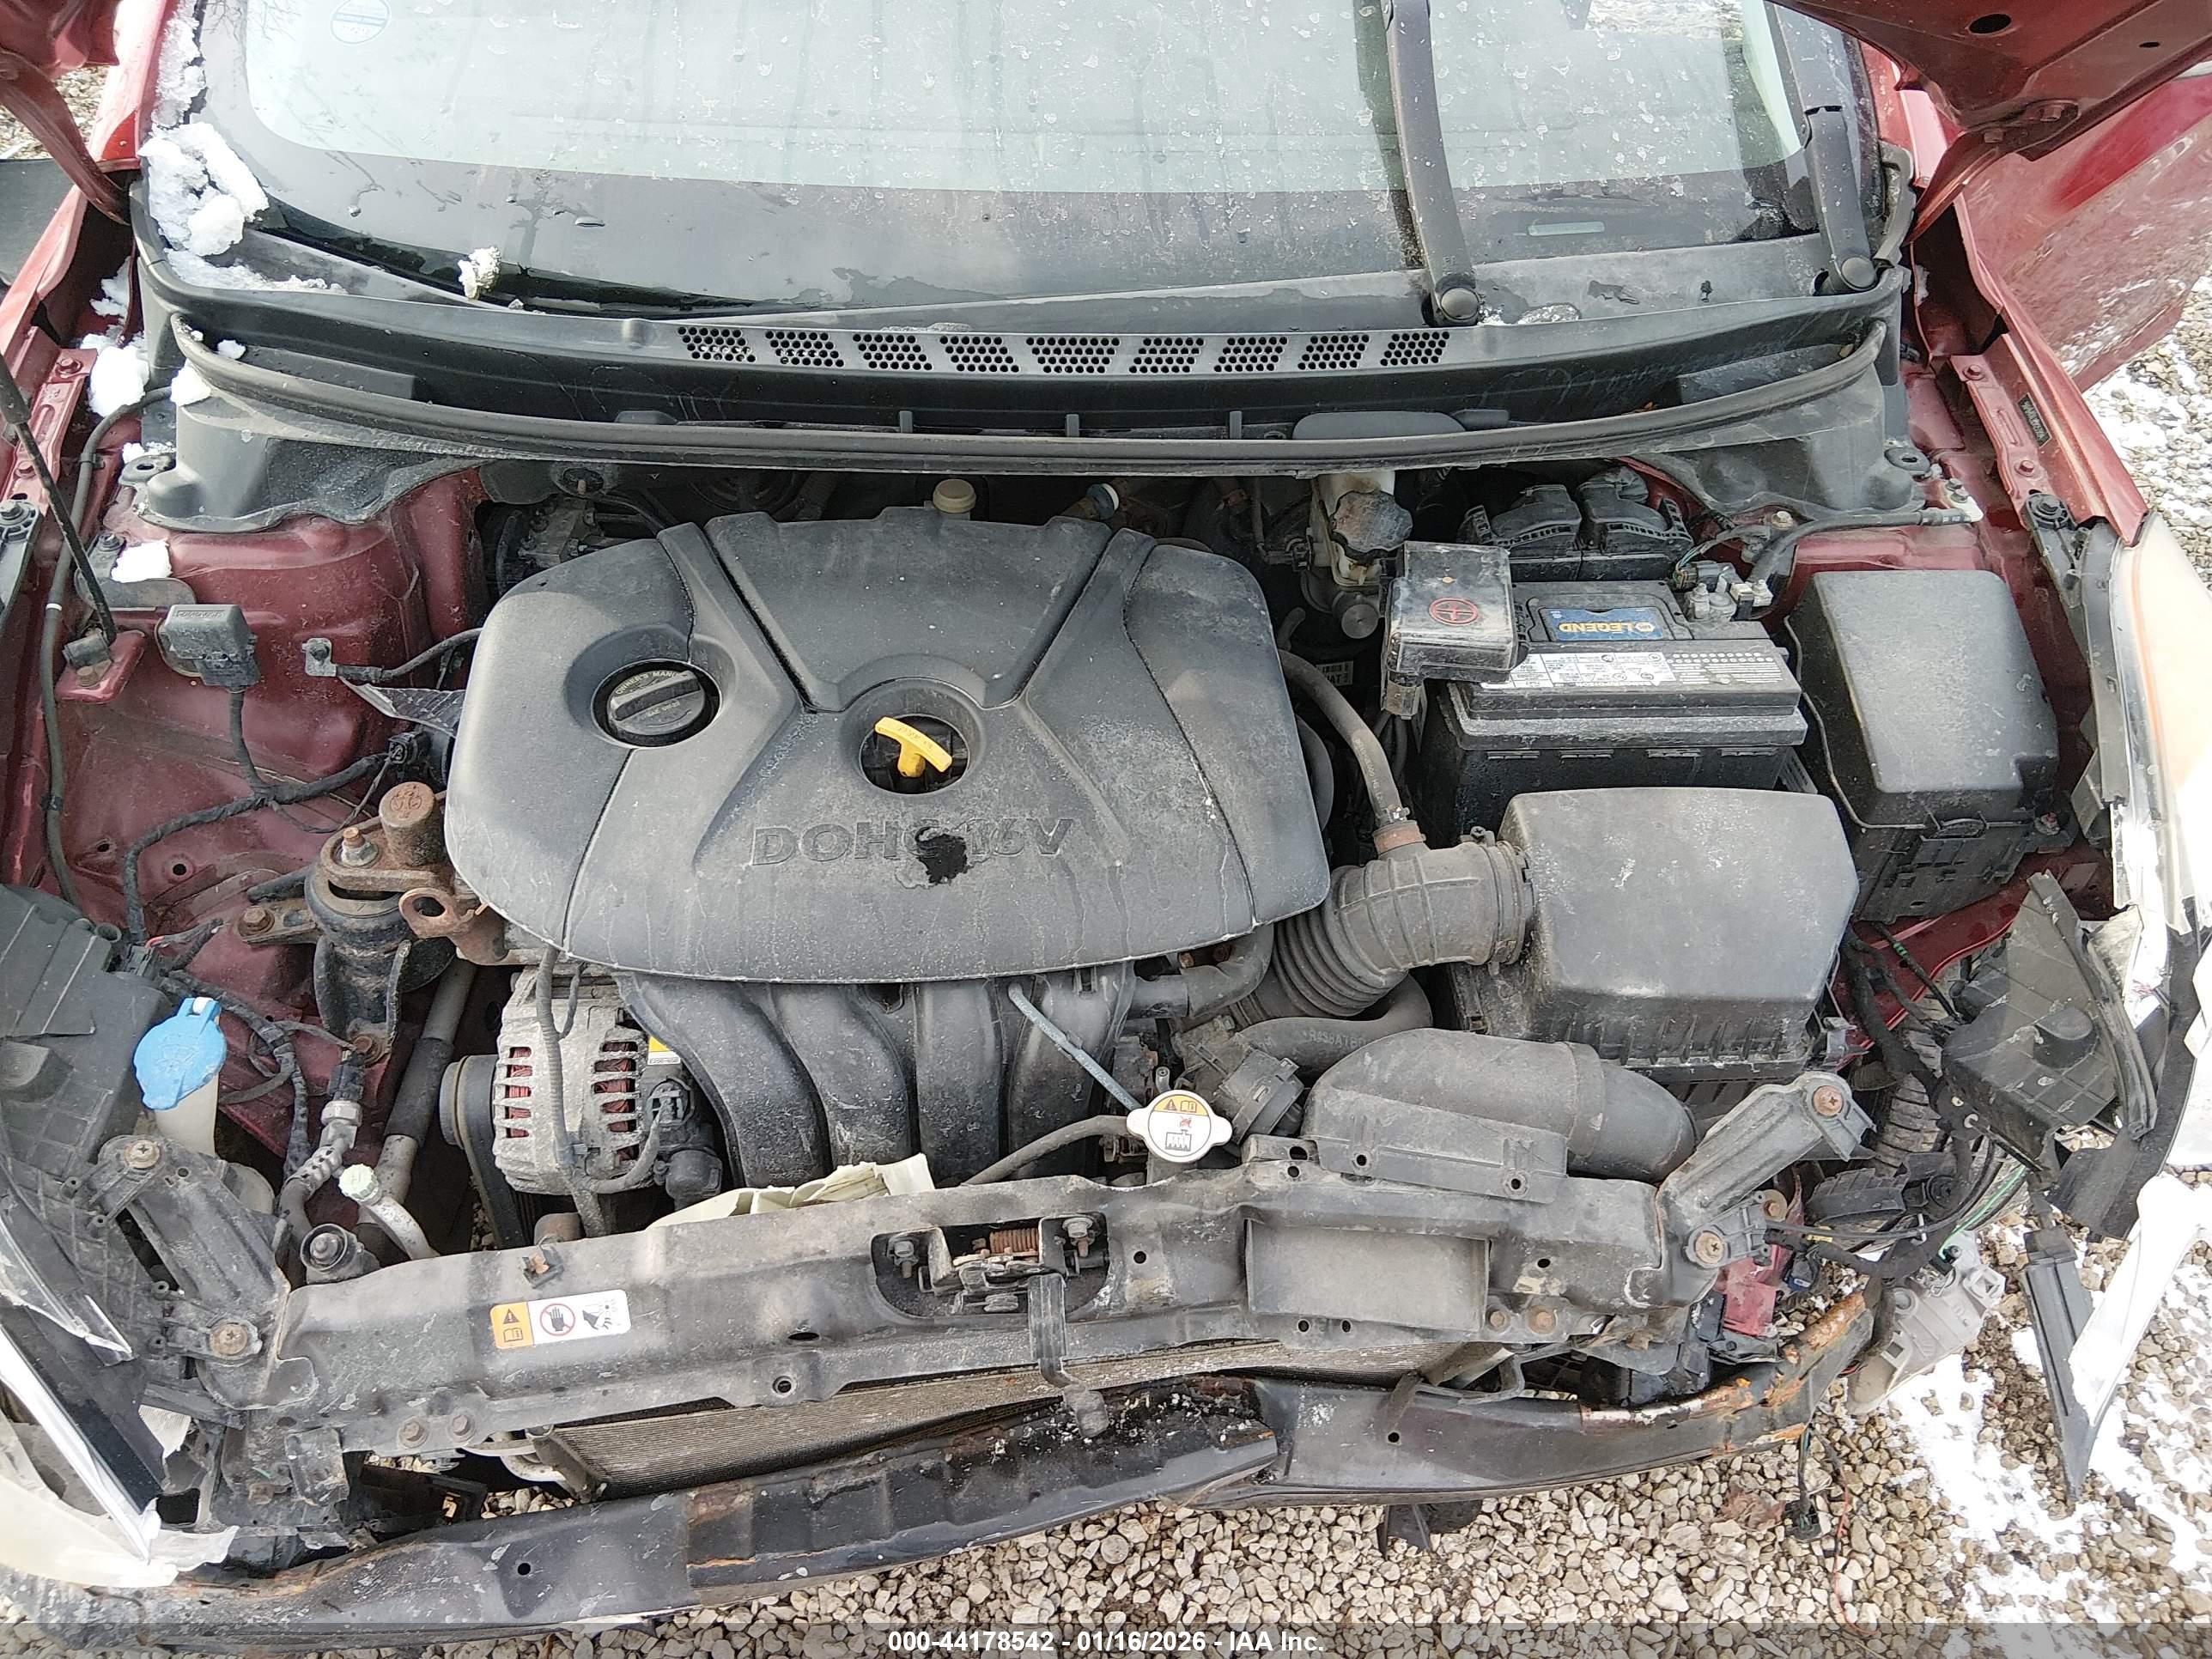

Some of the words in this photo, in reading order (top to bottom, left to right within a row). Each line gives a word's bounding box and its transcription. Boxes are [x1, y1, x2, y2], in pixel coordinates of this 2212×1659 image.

[1559, 622, 1632, 632] LEGEND
[615, 673, 649, 695] OWNER'S
[751, 818, 943, 866] DOHC
[965, 817, 1074, 857] 16V
